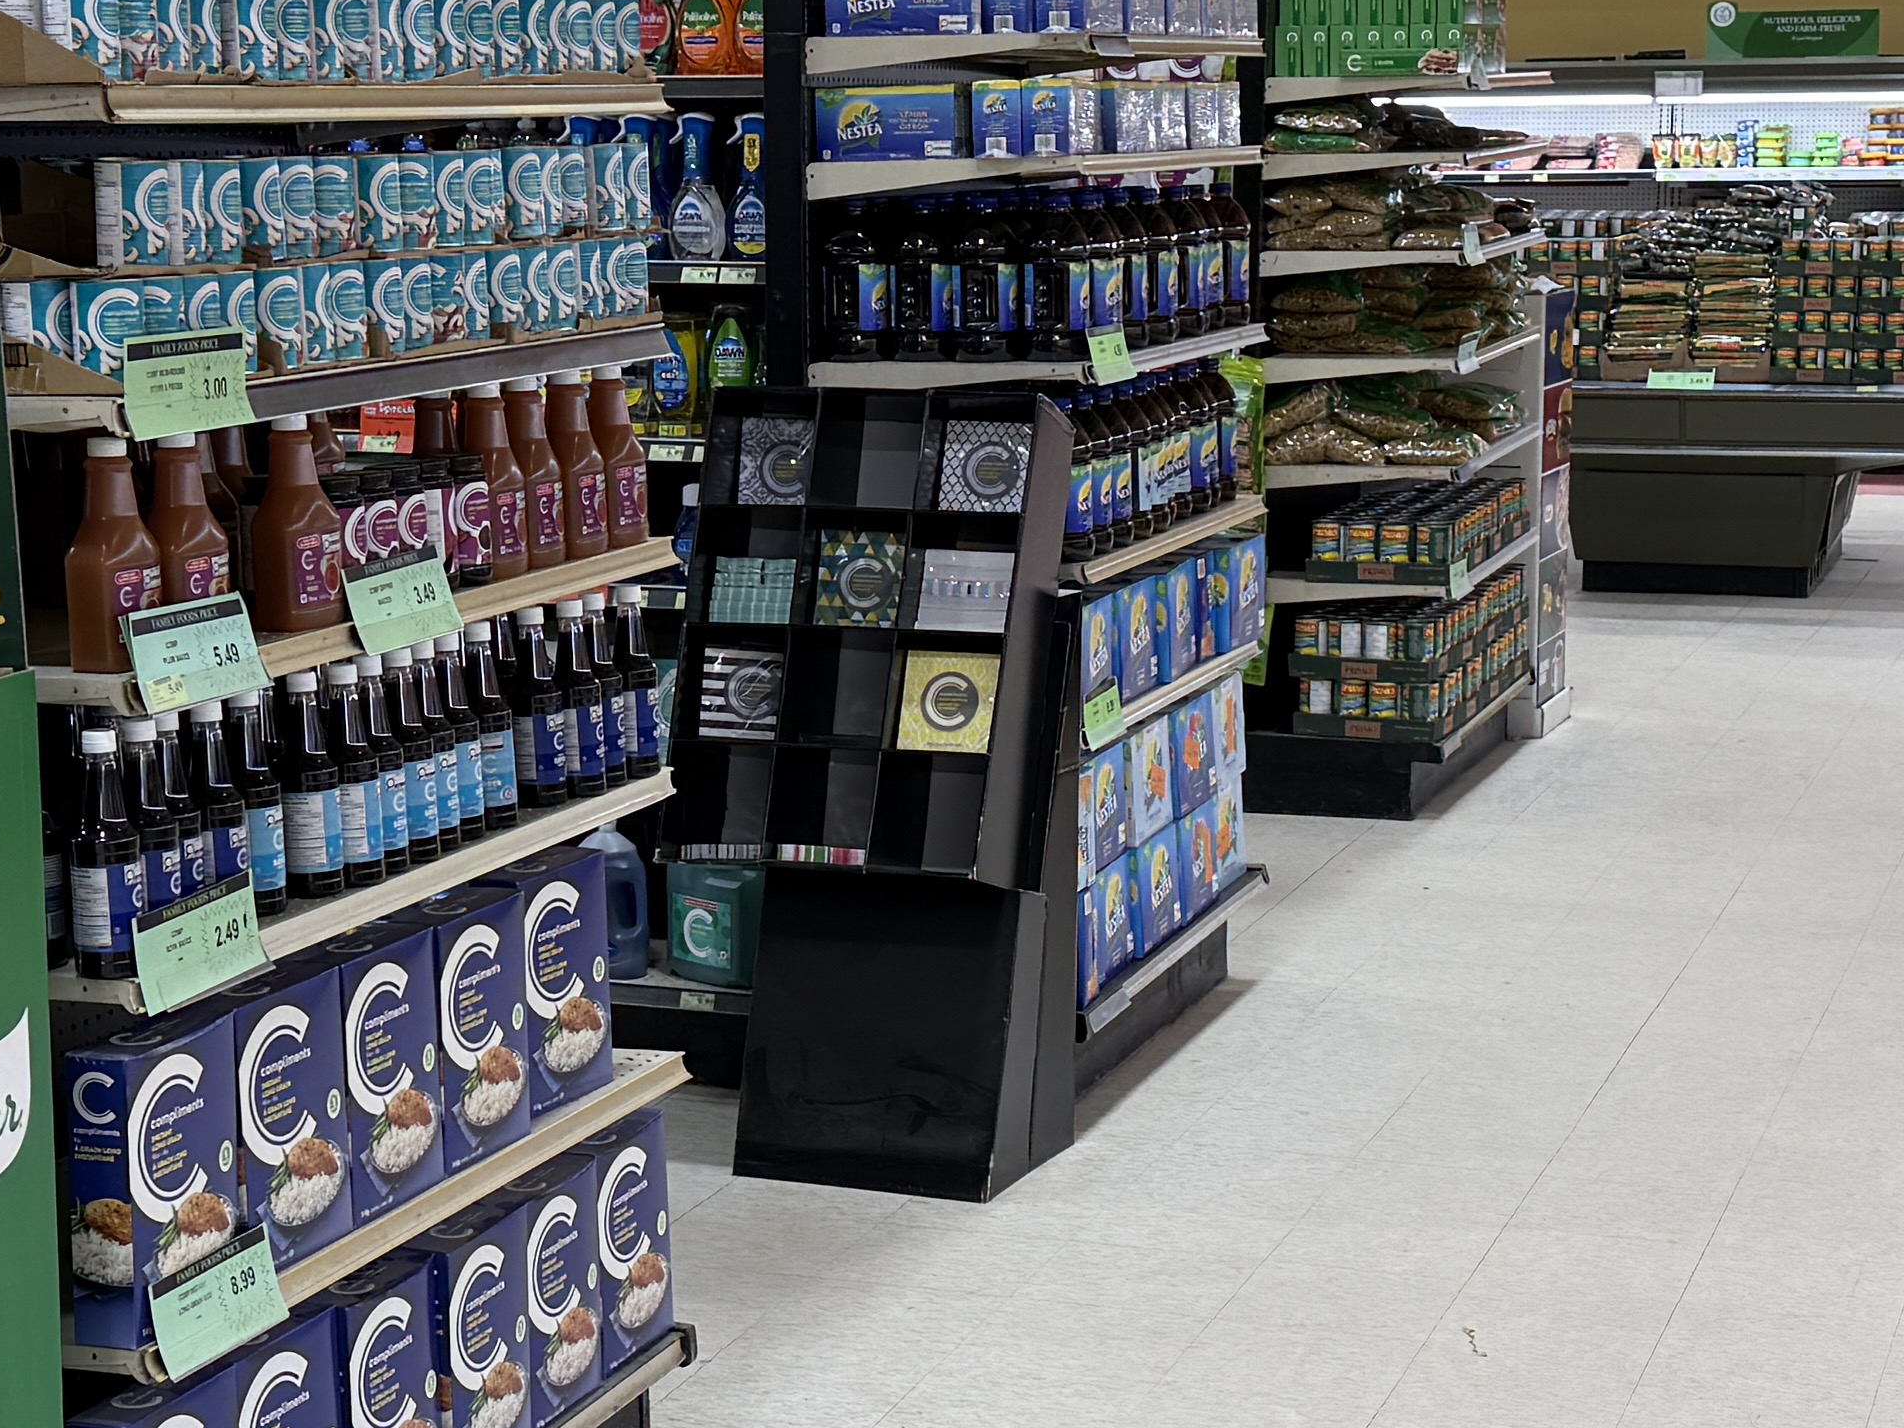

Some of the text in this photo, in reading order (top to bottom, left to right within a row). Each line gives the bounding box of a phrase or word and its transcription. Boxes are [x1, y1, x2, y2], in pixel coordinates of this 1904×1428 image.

[837, 122, 883, 143] NESTEA
[714, 347, 745, 360] DAWN
[203, 377, 228, 400] 3.00
[415, 581, 437, 605] 3.49
[213, 643, 241, 667] 5.49
[214, 917, 240, 947] 2.49
[536, 918, 581, 943] compliments
[458, 964, 502, 989] compliments
[364, 1003, 410, 1031] compliments
[260, 1046, 312, 1078] compliments
[149, 1097, 205, 1131] compliments
[229, 1265, 256, 1295] 8.99
[464, 1280, 506, 1314] compliments
[368, 1333, 414, 1369] compliments
[259, 1390, 311, 1427] compliments
